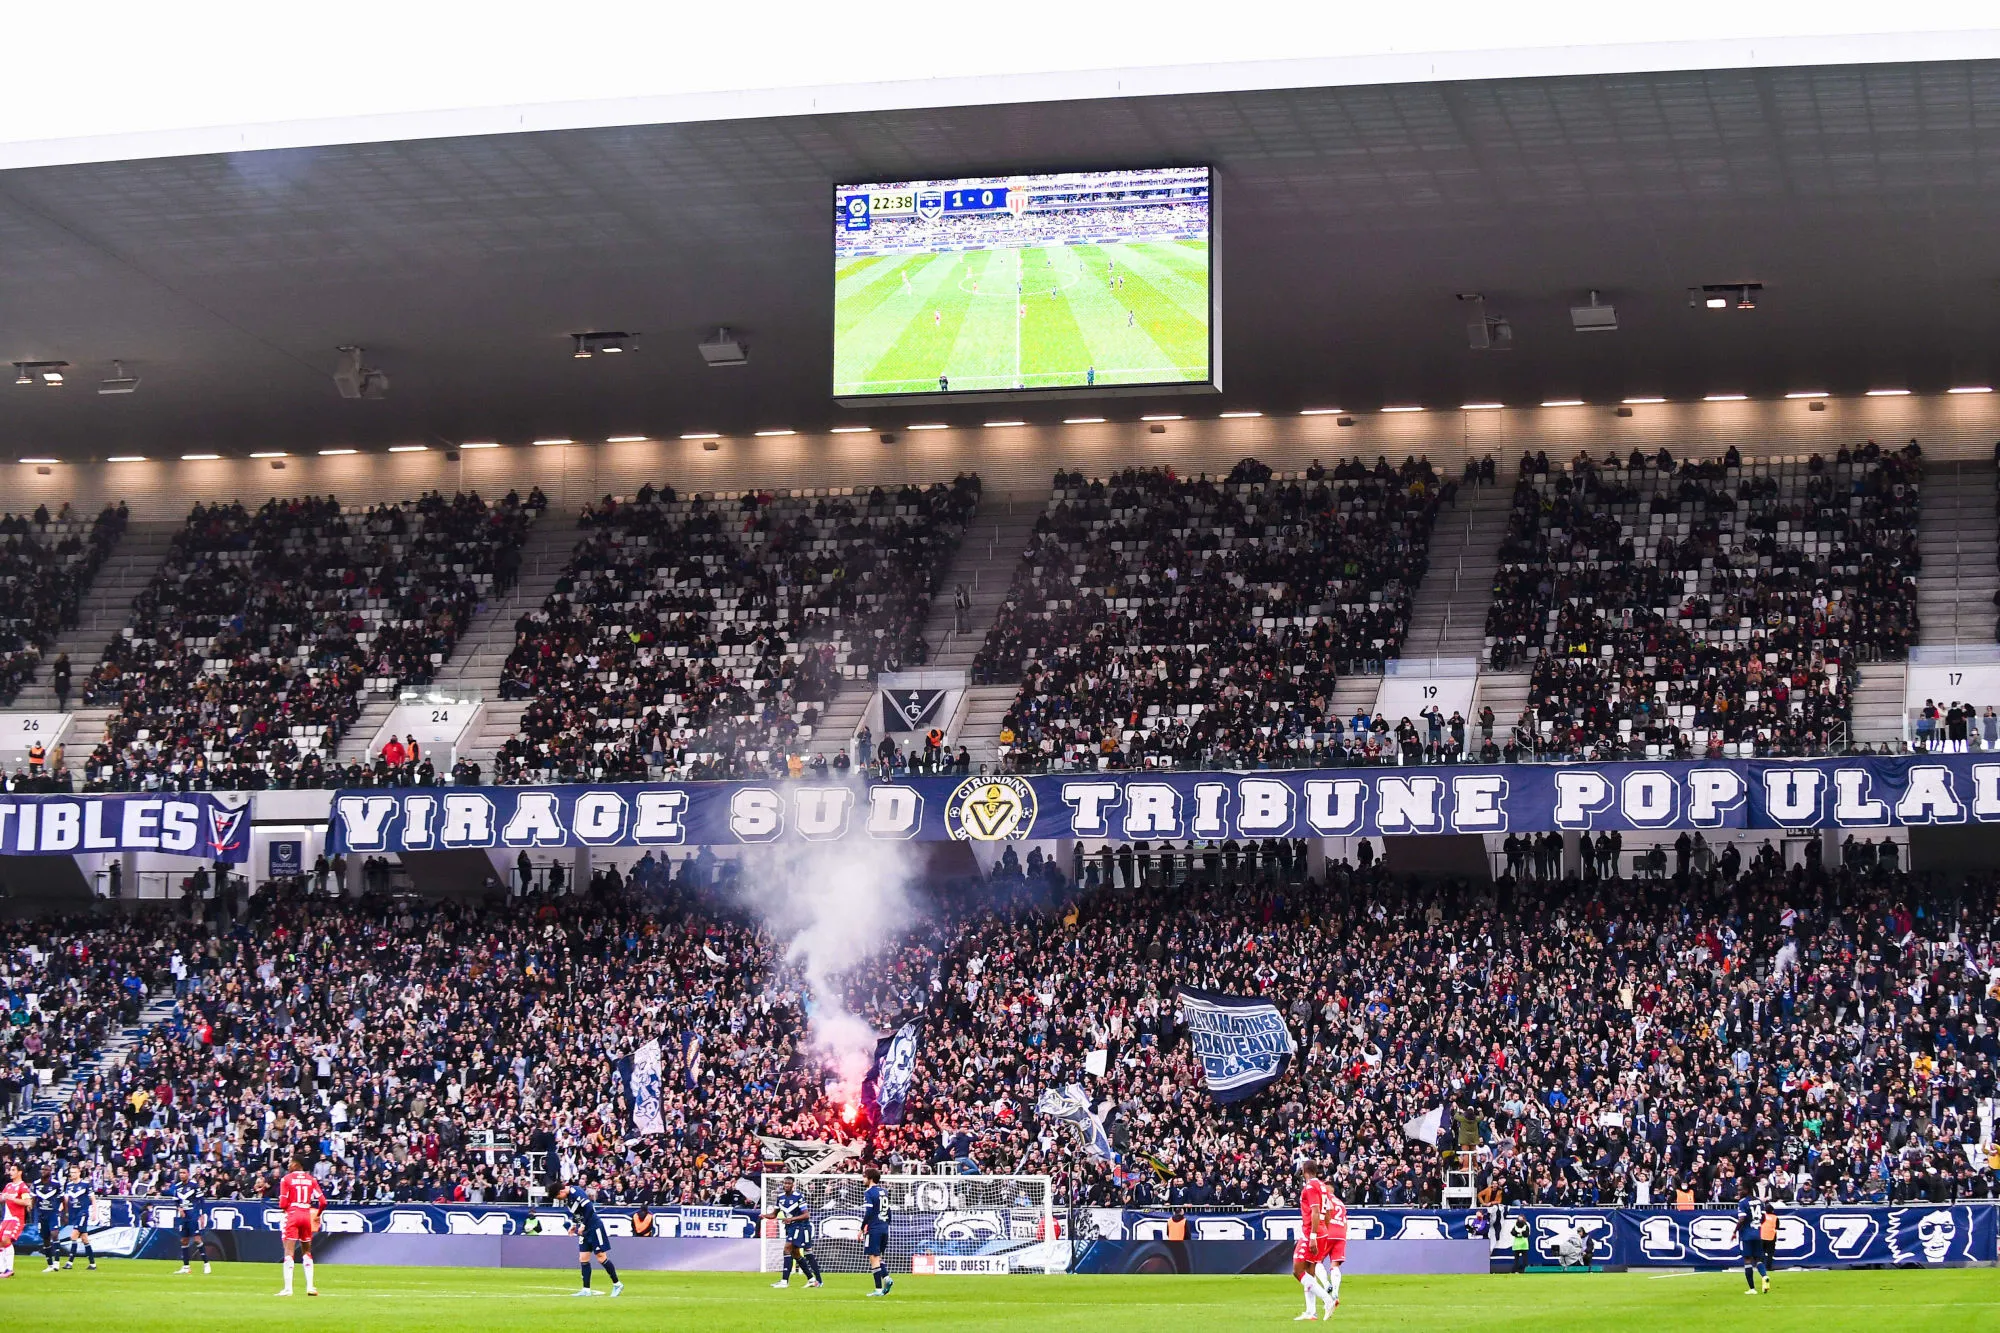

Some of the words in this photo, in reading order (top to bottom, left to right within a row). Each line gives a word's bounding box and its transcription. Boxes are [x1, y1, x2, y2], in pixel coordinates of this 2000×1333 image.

[873, 196, 913, 210] 22:38
[952, 192, 963, 207] 1
[981, 191, 994, 206] 0
[1949, 673, 1963, 686] 17
[1423, 686, 1438, 698] 19
[432, 711, 448, 722] 24
[23, 719, 39, 731] 26
[958, 776, 1029, 799] GIRONDINS
[337, 791, 689, 851] VIRAGE
[731, 785, 924, 843] SUD
[1062, 774, 1509, 839] TRIBUNE
[295, 1186, 308, 1203] 11
[879, 1196, 889, 1211] 19
[683, 1208, 731, 1218] THIERRY
[1750, 1205, 1762, 1220] 14
[685, 1222, 700, 1231] ON
[708, 1223, 727, 1231] EST
[938, 1260, 957, 1271] SUD
